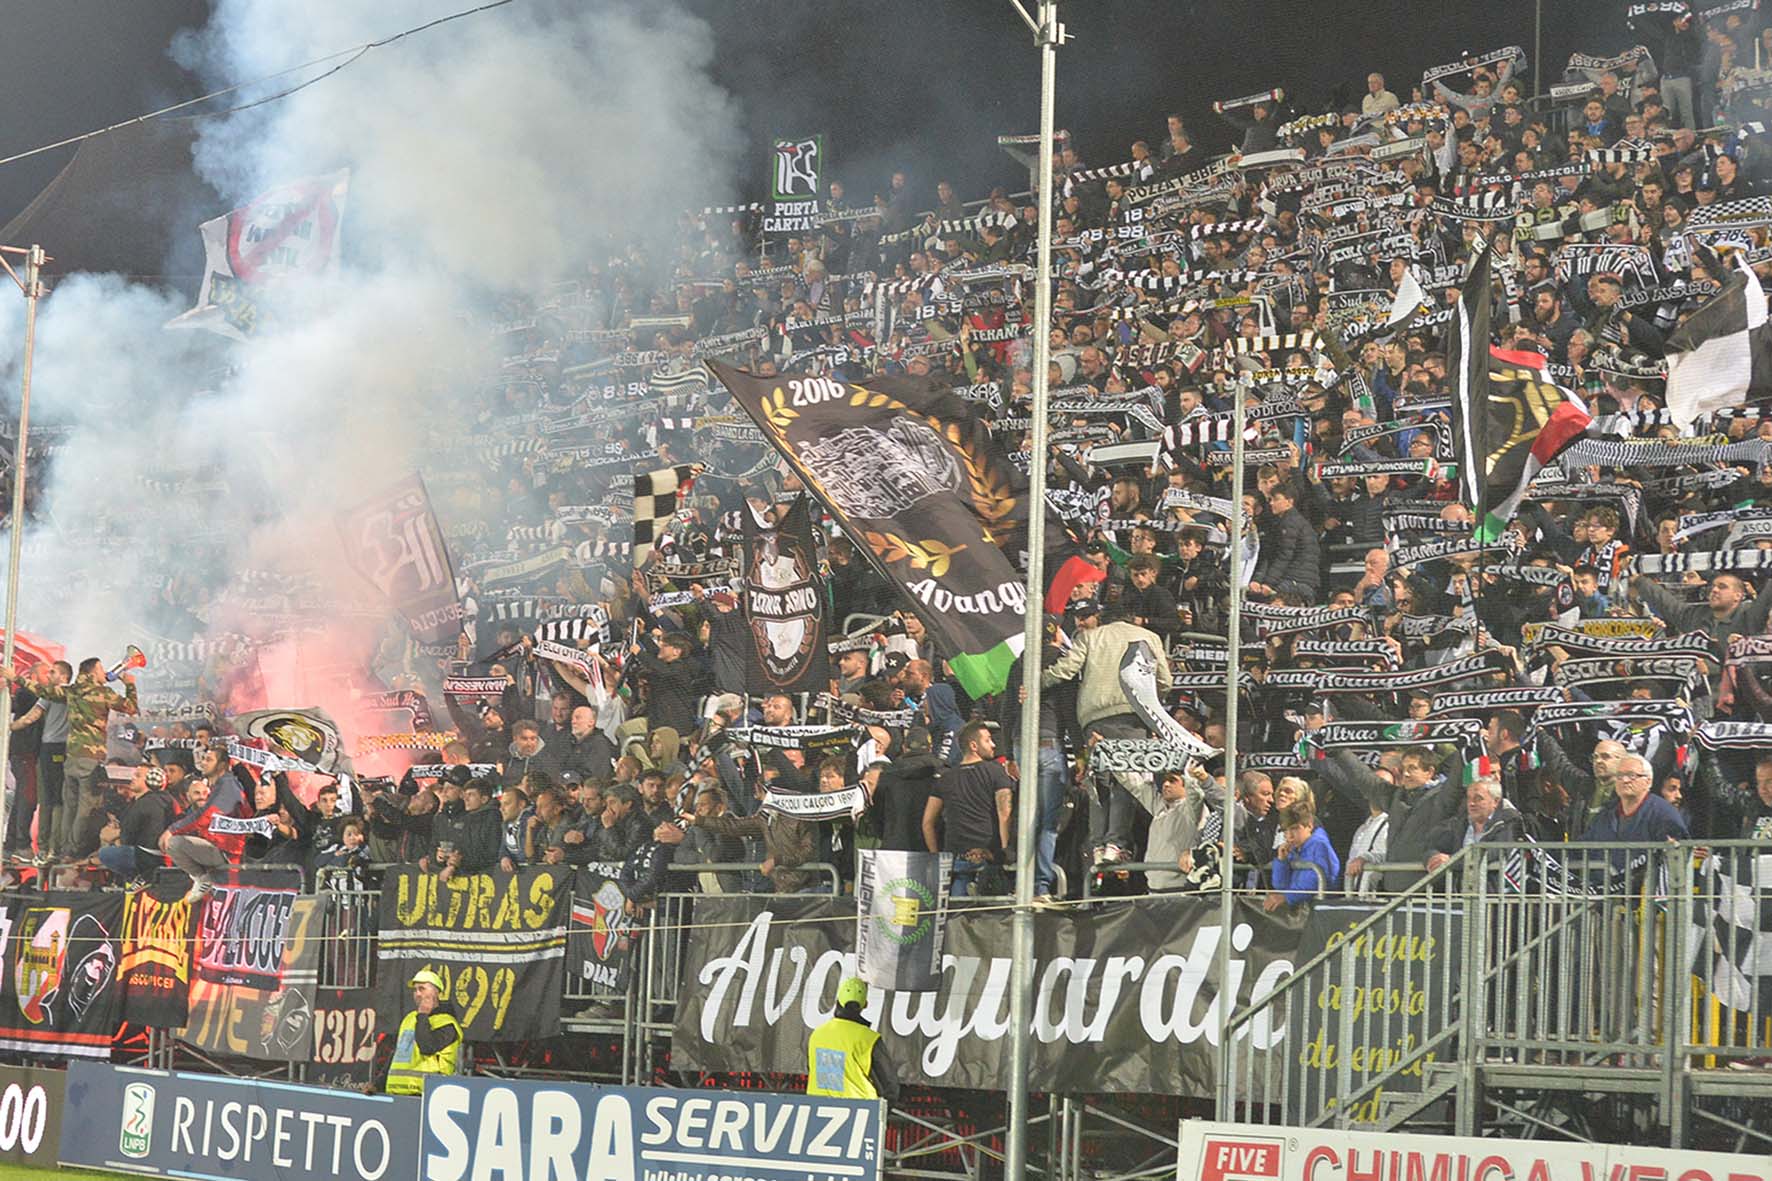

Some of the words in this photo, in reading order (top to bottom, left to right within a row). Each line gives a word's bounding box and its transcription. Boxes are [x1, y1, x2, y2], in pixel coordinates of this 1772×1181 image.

[774, 200, 818, 217] PORTA
[788, 377, 846, 408] 2016
[750, 591, 783, 615] ZONA
[785, 587, 817, 615] ARNO
[396, 872, 556, 931] ULTRAS
[583, 960, 618, 988] DIAZ
[313, 1008, 377, 1064] 1312
[170, 1096, 391, 1181] RISPETTO
[427, 1085, 636, 1181] SARA
[640, 1097, 870, 1159] SERVIZI
[124, 1136, 146, 1152] LNPB
[1217, 1146, 1268, 1173] FIVE
